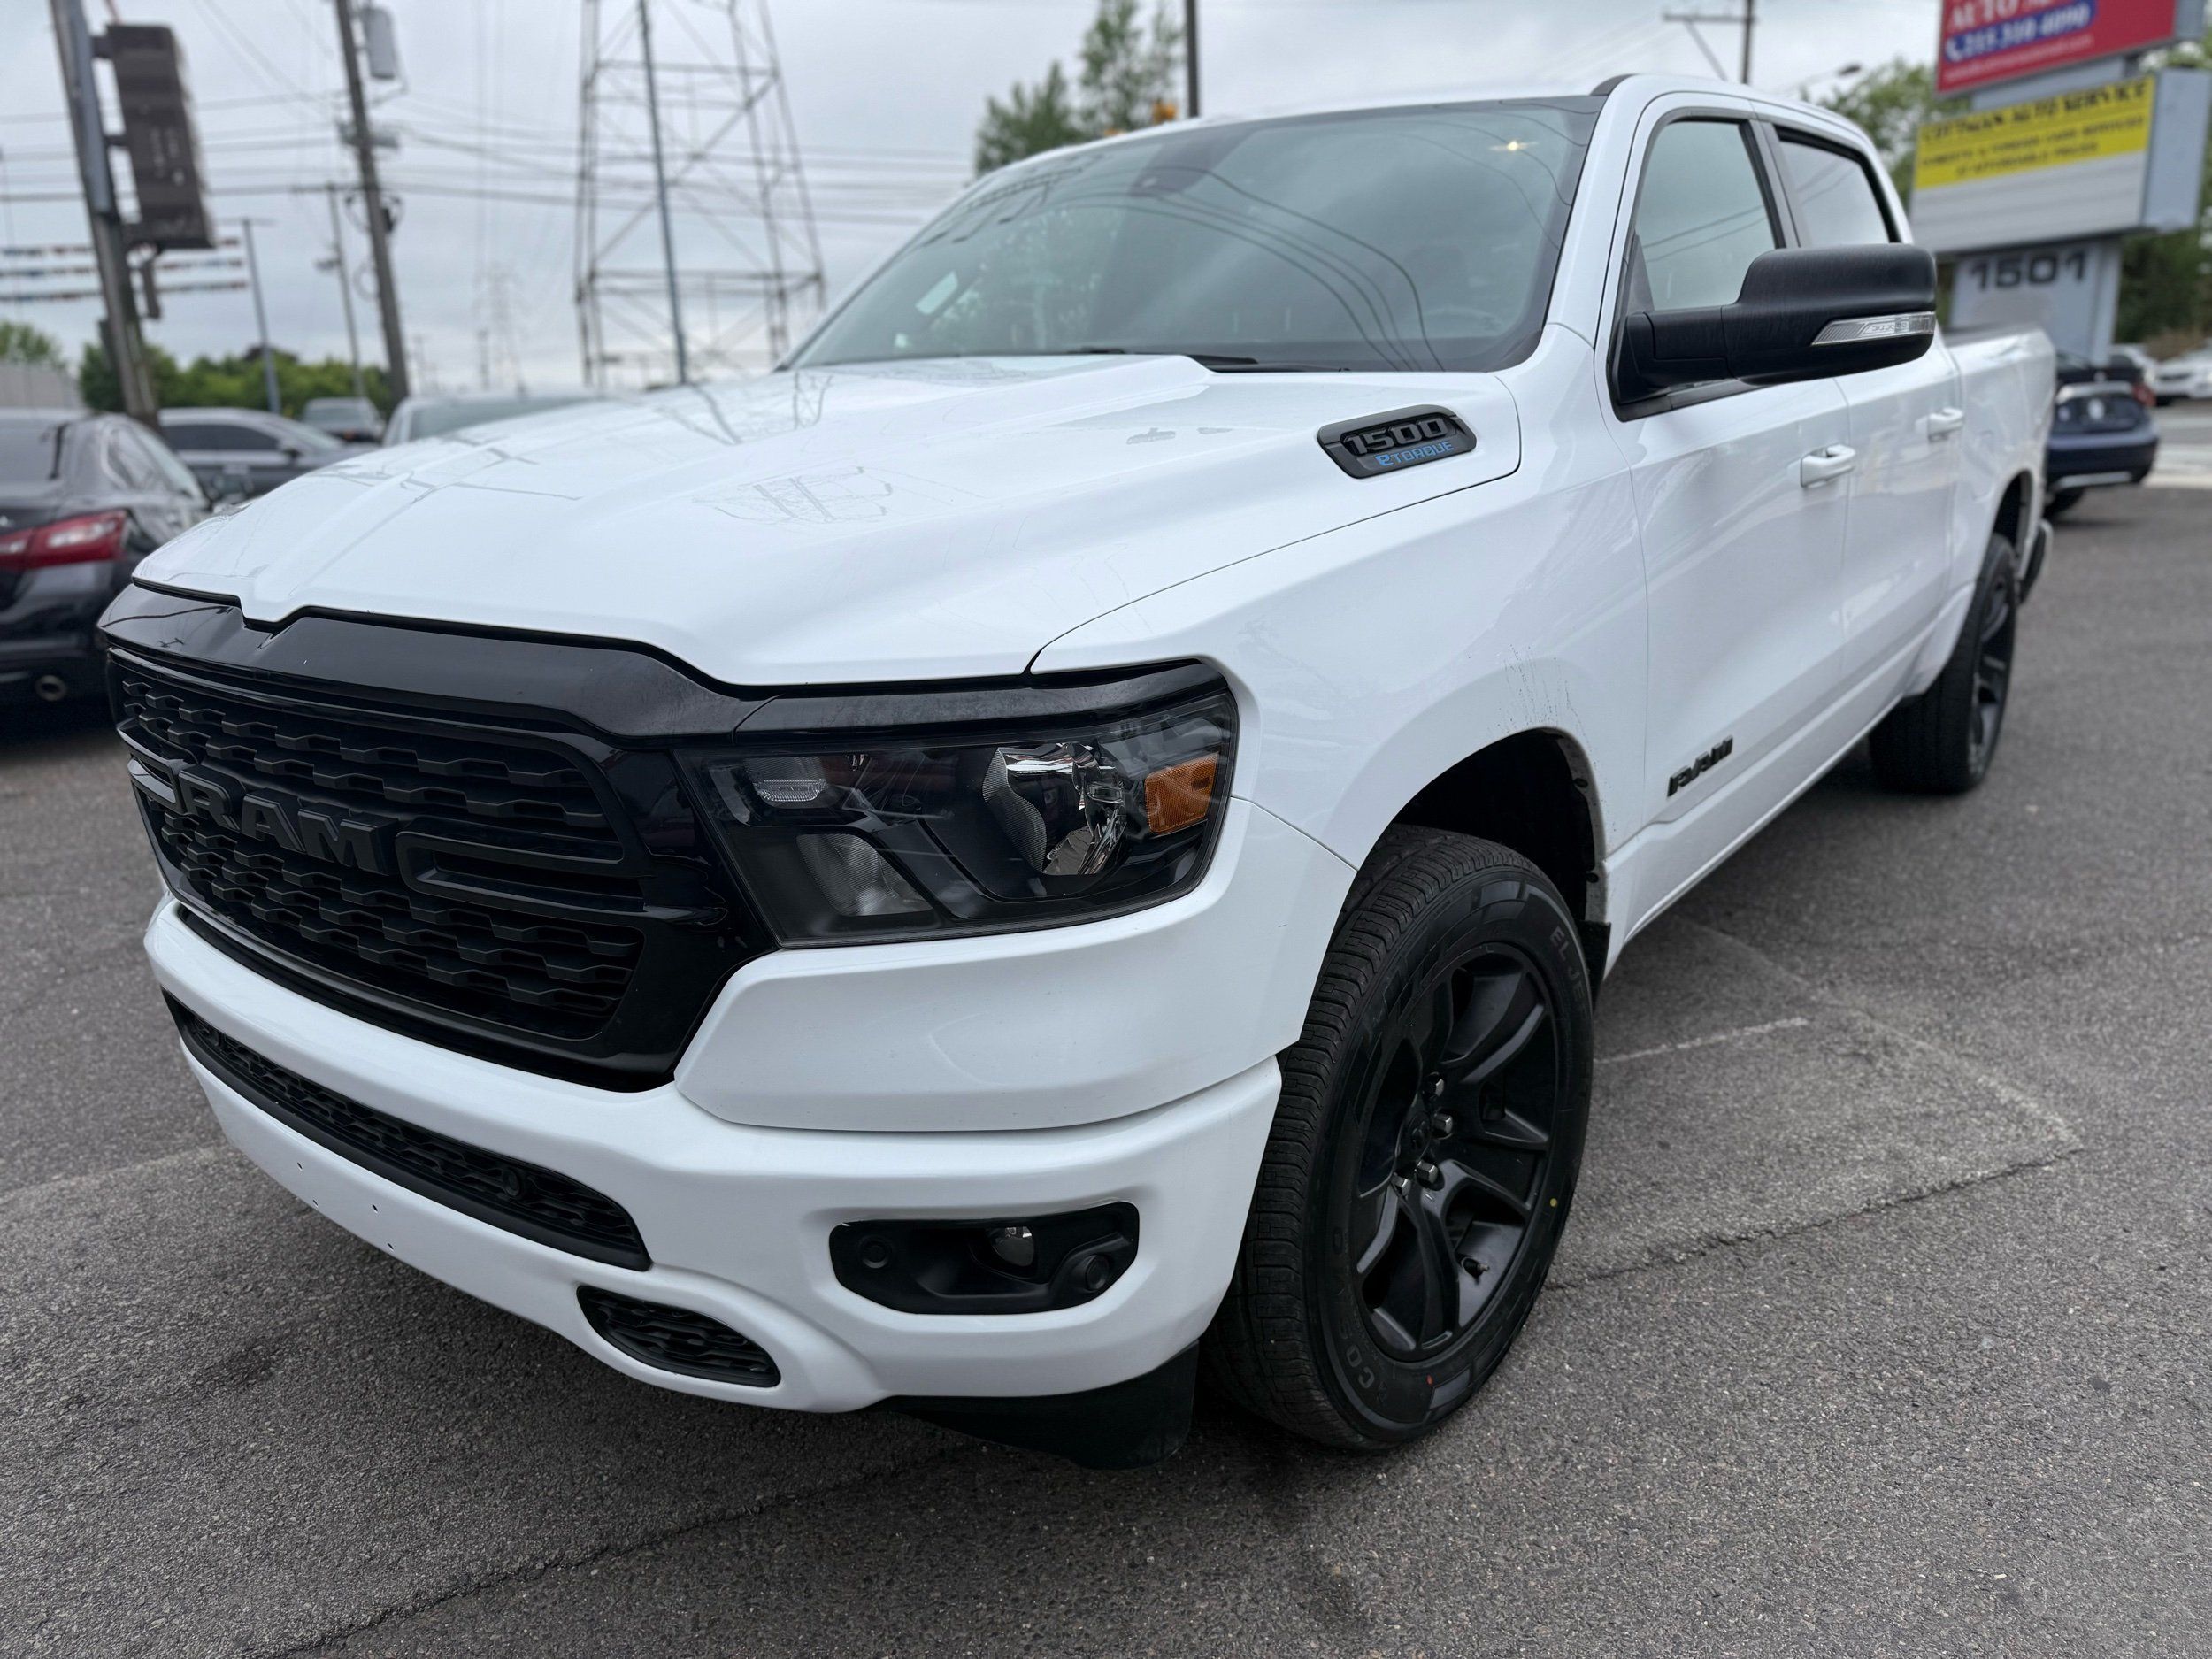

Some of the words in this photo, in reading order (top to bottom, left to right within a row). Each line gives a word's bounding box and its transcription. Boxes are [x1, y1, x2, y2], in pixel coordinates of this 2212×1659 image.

[1968, 250, 2087, 290] 1501
[1343, 417, 1449, 457] 1500
[1667, 734, 1733, 797] RAM
[178, 763, 394, 876] RAM
